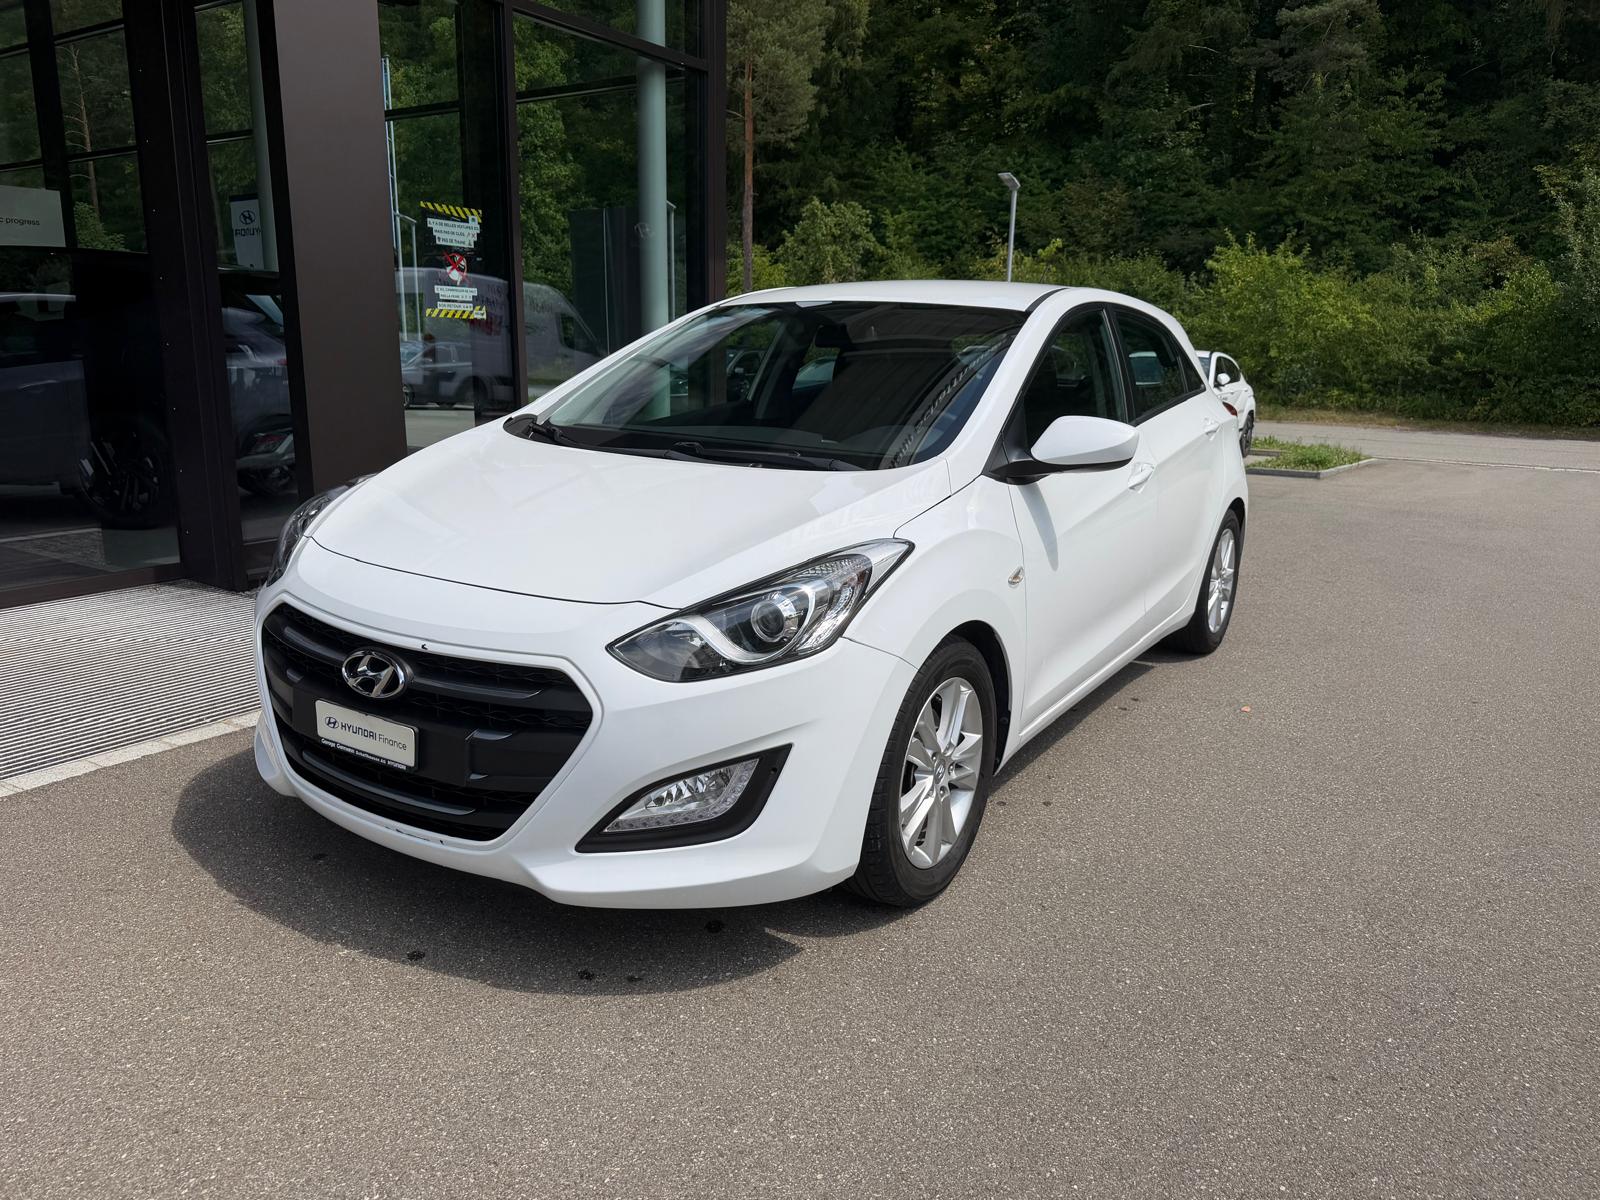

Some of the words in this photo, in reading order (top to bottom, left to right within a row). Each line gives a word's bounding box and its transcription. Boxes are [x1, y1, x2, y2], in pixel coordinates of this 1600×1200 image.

[6, 217, 40, 226] progress
[340, 721, 377, 741] HYUNDAI
[378, 733, 407, 751] Finance
